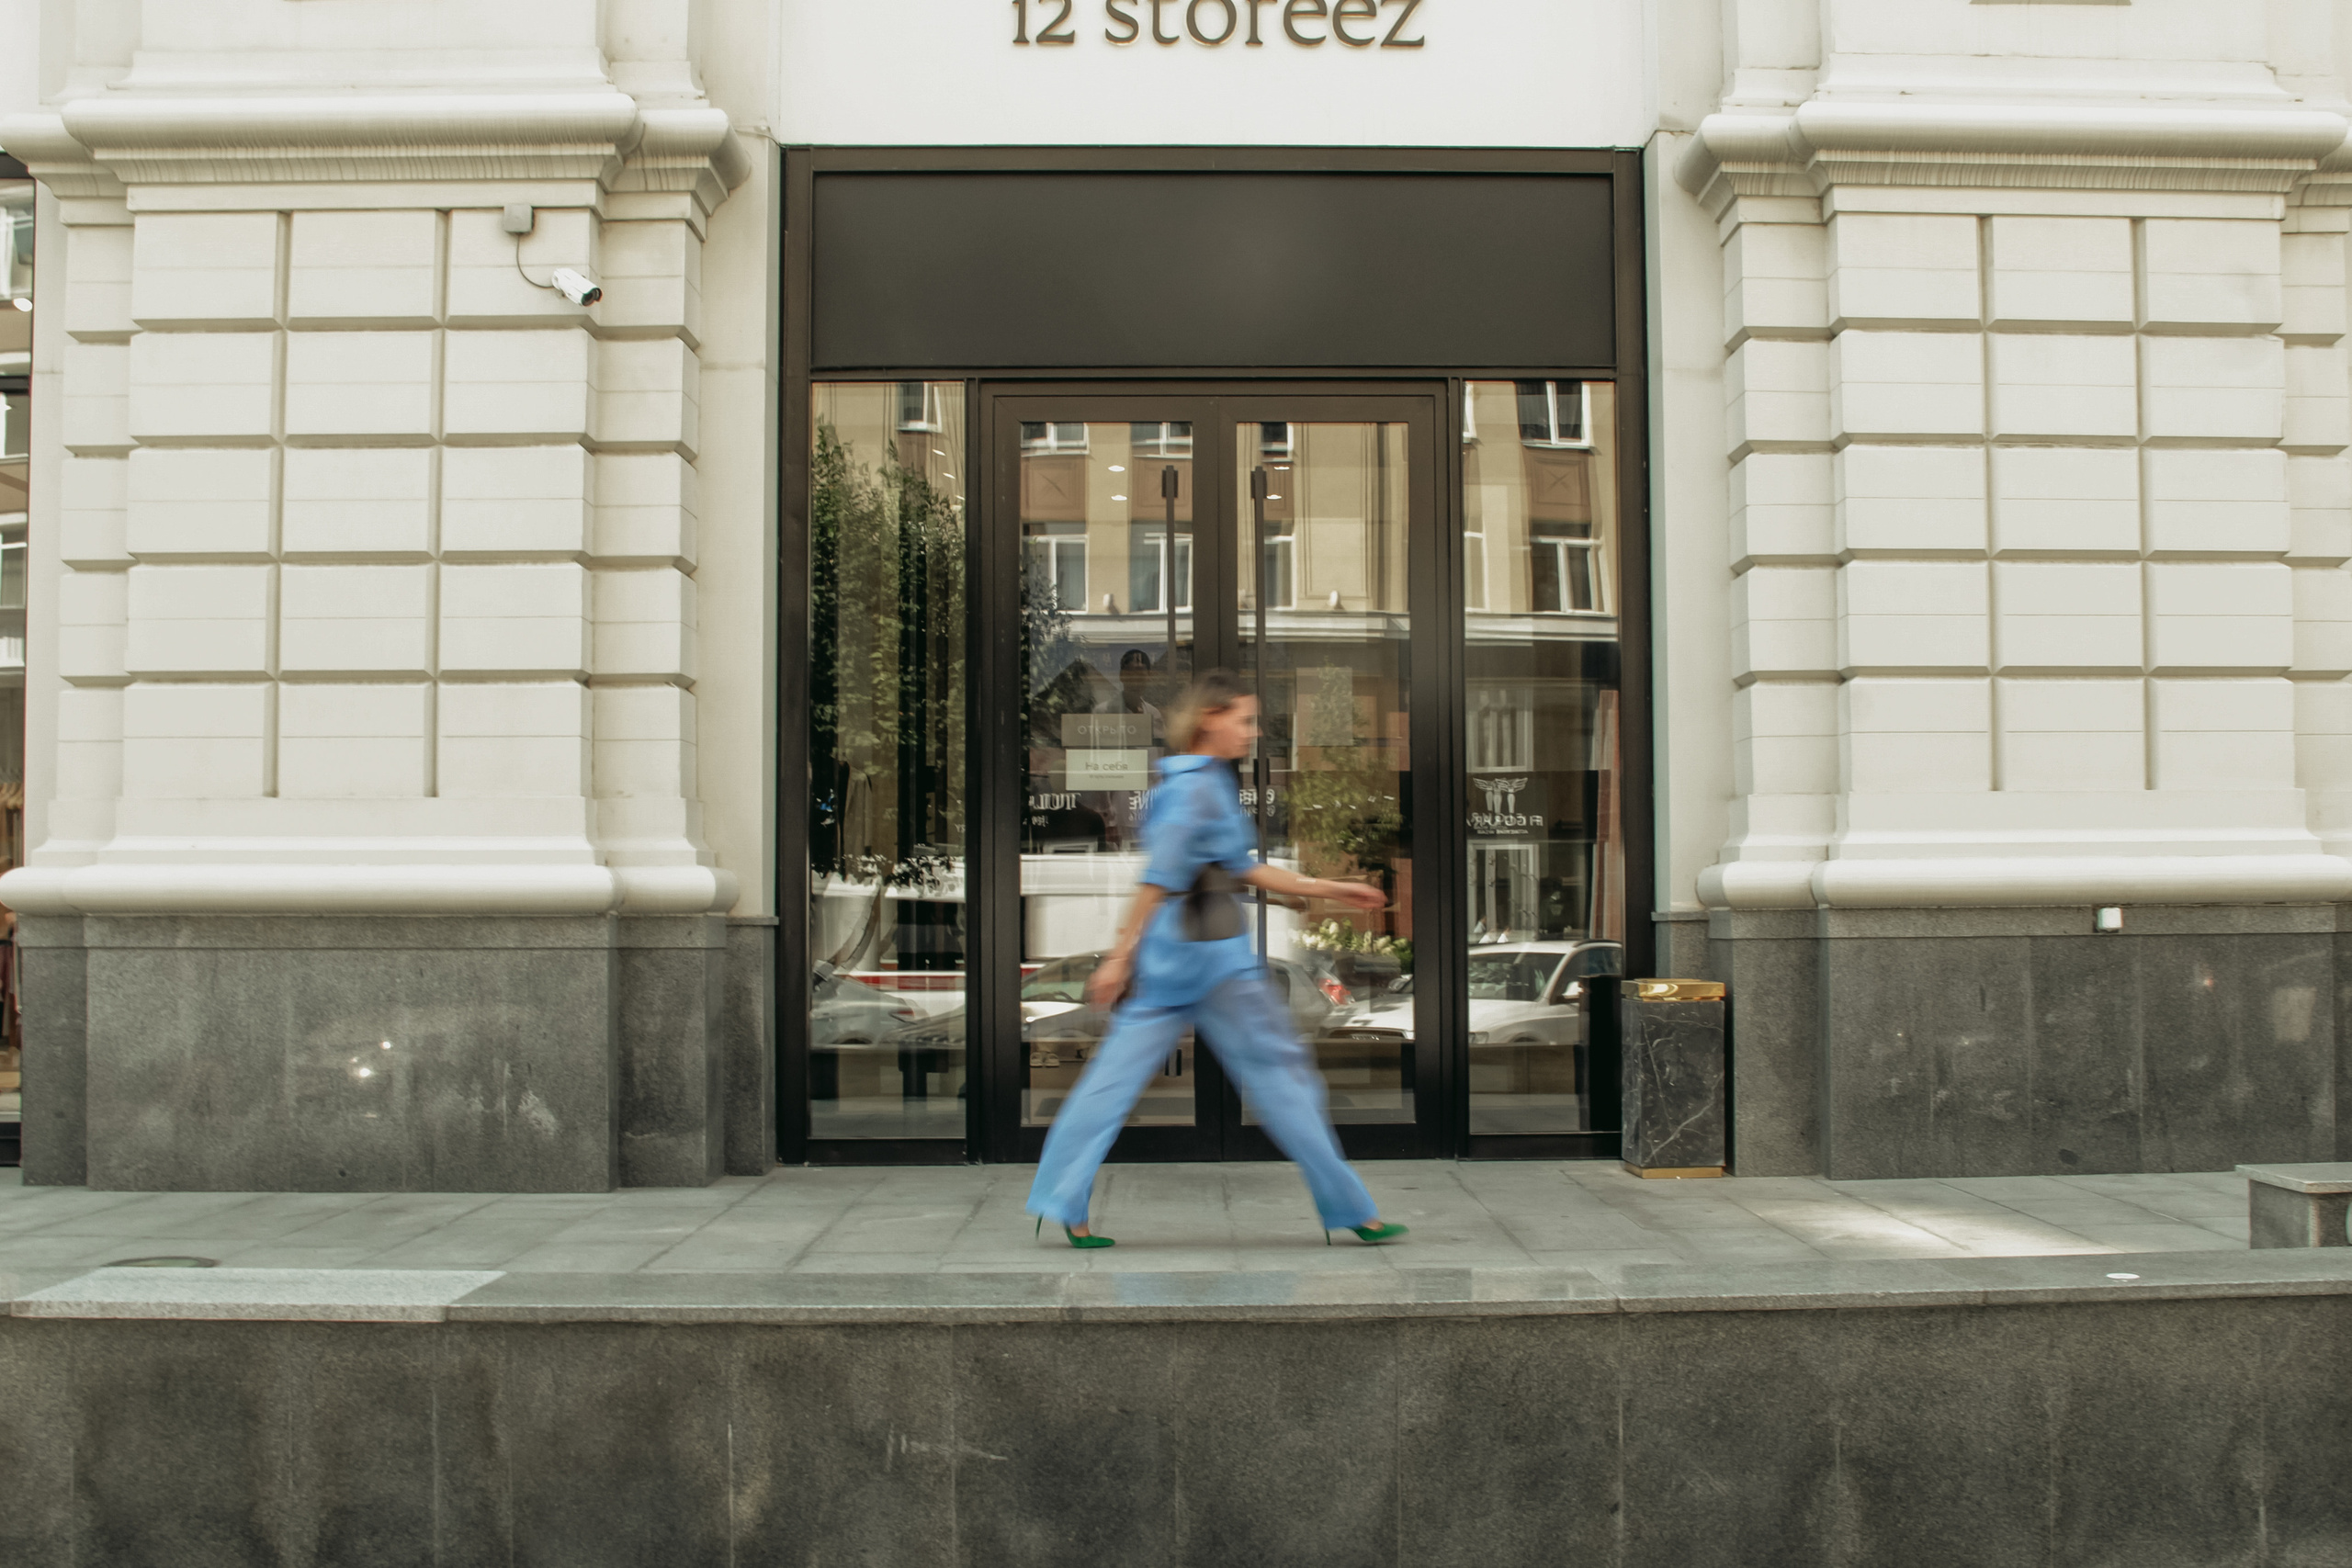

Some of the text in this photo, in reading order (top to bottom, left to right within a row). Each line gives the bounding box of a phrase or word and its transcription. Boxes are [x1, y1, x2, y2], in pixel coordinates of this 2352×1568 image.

[1104, 0, 1426, 48] storeez
[1077, 725, 1137, 735] ОТКРЫТО
[1085, 761, 1129, 771] На себя
